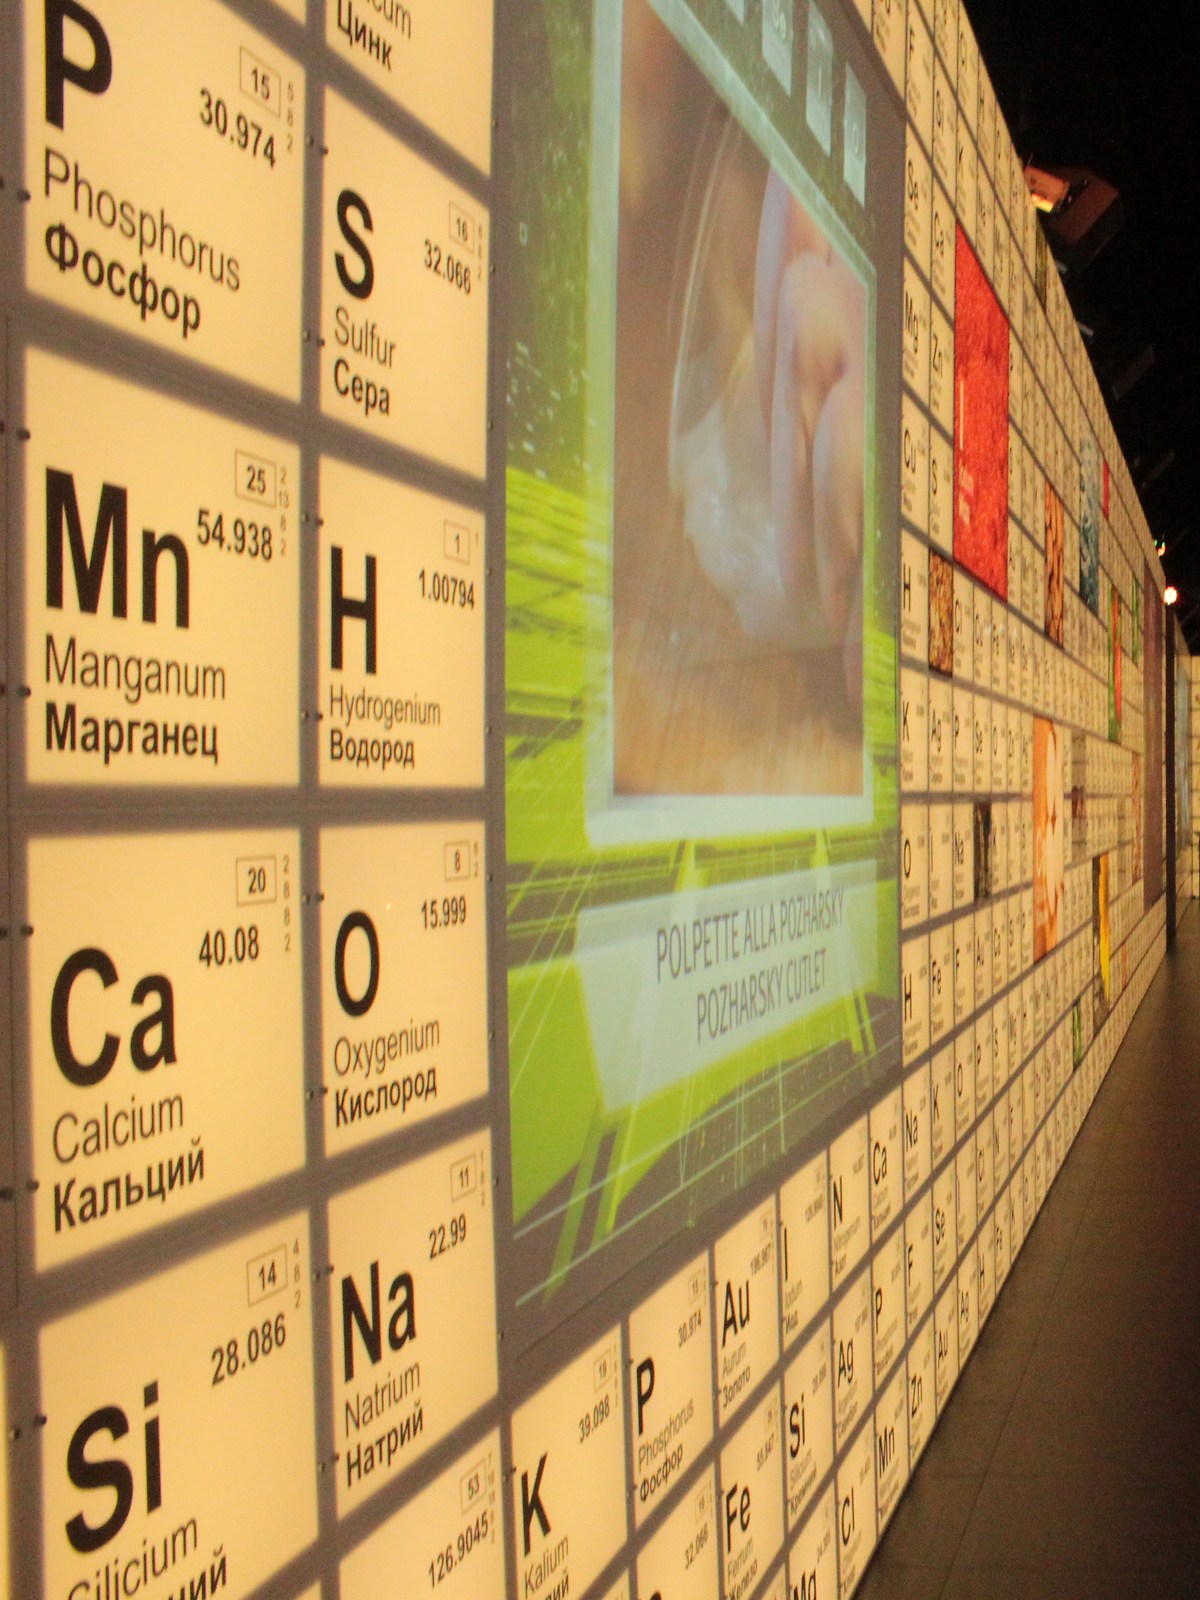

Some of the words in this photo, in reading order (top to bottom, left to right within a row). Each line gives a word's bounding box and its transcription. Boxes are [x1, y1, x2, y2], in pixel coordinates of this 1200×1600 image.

[337, 0, 392, 71] Цинк
[44, 0, 112, 131] P
[250, 67, 270, 100] 15
[199, 88, 276, 168] 30.974
[44, 147, 240, 291] Phosphorus
[335, 188, 374, 300] S
[44, 223, 201, 338] Фосфор
[423, 239, 471, 296] 32.066
[335, 306, 396, 369] Sulfur
[334, 357, 391, 416] Сера
[247, 465, 266, 495] 25
[903, 430, 917, 475] Cu
[46, 466, 190, 629] Mn
[197, 508, 272, 561] 54.938
[330, 545, 377, 675] H
[418, 569, 475, 611] 1.00794
[903, 564, 911, 613] H
[46, 634, 226, 704] Manganum
[46, 701, 219, 765] Марганец
[330, 685, 441, 728] Hydrogenium
[903, 701, 910, 741] K
[931, 709, 942, 752] Ag
[330, 729, 415, 770] Водород
[248, 867, 266, 895] 20
[454, 852, 461, 873] 8
[904, 839, 912, 878] O
[421, 896, 467, 930] 15.999
[657, 911, 739, 983] POLPETTE
[744, 903, 777, 956] ALLA
[780, 887, 845, 943] POZHARSKY
[199, 926, 259, 968] 40.08
[334, 910, 380, 1017] O
[697, 965, 783, 1045] POZHARSKY
[787, 948, 827, 1003] CUTLET
[904, 974, 912, 1021] H
[931, 960, 941, 997] Fe
[51, 947, 178, 1087] Ca
[334, 1019, 440, 1079] Oxygenium
[335, 1067, 437, 1127] Кислород
[933, 1085, 940, 1124] K
[53, 1094, 184, 1164] Calcium
[906, 1110, 918, 1151] Na
[54, 1137, 204, 1234] Кальций
[873, 1142, 888, 1185] Ca
[833, 1176, 843, 1230] N
[935, 1208, 945, 1245] Se
[429, 1214, 466, 1261] 22.99
[907, 1245, 913, 1286] F
[259, 1261, 277, 1291] 14
[341, 1260, 417, 1384] Na
[722, 1280, 750, 1349] Au
[875, 1287, 882, 1334] P
[212, 1313, 287, 1388] 28.086
[837, 1339, 854, 1387] Ag
[938, 1330, 949, 1361] Au
[344, 1362, 420, 1438] Natrium
[636, 1356, 655, 1436] P
[723, 1367, 750, 1409] Золото
[911, 1375, 923, 1419] Zn
[345, 1401, 424, 1488] Натрий
[579, 1399, 609, 1443] 39.098
[638, 1398, 695, 1475] Phosphorus
[790, 1392, 806, 1459] Si
[65, 1379, 162, 1553] Si
[639, 1443, 684, 1503] Фосфор
[878, 1427, 895, 1478] Mn
[468, 1474, 480, 1500] 53
[521, 1451, 551, 1557] K
[726, 1483, 751, 1553] Fe
[841, 1487, 855, 1545] Cl
[428, 1511, 489, 1588] 126.9045
[523, 1536, 569, 1600] Kalium
[685, 1523, 708, 1570] 32.066
